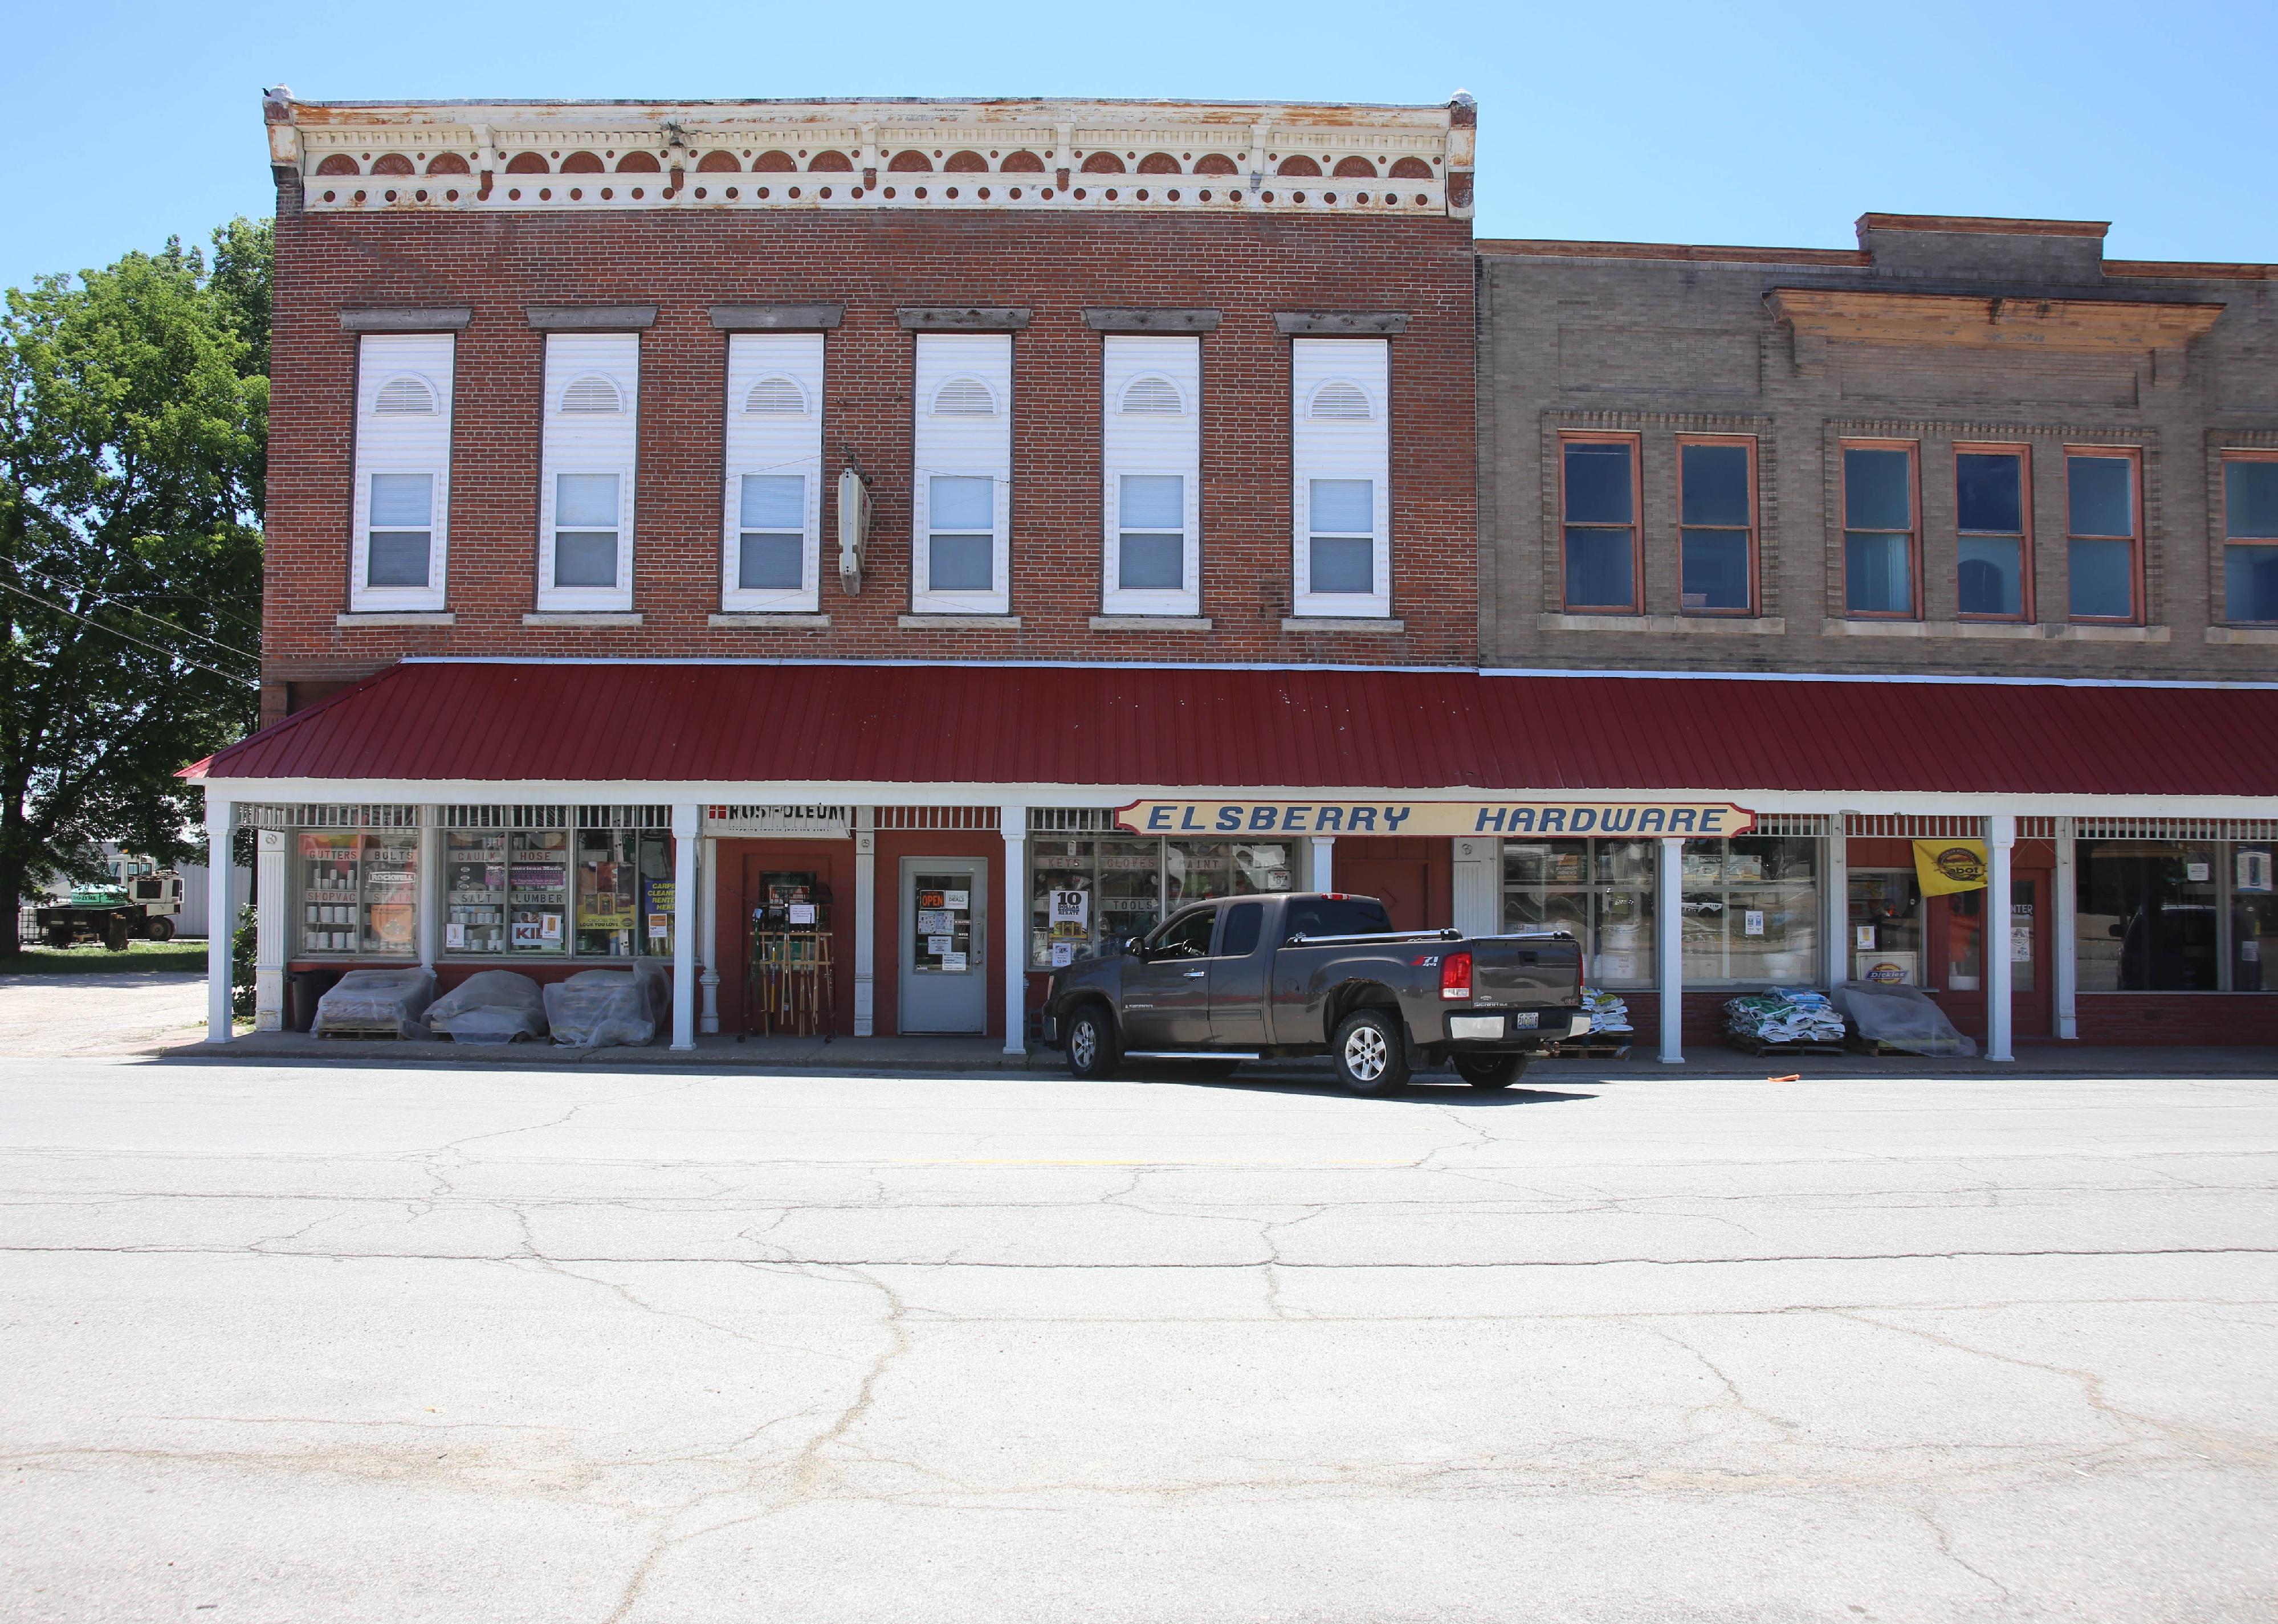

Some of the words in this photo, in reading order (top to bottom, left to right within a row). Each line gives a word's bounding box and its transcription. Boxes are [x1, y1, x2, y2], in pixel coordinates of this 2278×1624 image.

[1147, 806, 1410, 831] ELSBERRY
[1474, 807, 1729, 833] HARDWARE
[309, 851, 356, 859] GUTTERS
[374, 851, 413, 860] BOLTS
[458, 852, 496, 861] CAULK
[520, 852, 551, 860] HOSE
[1048, 858, 1080, 867] KEYS
[1107, 858, 1155, 867] GLOVES
[308, 892, 356, 901] SHOPVAC
[374, 893, 412, 901] STAIN
[462, 894, 492, 903] SALT
[516, 894, 563, 903] LUMBER
[922, 895, 943, 907] OPEN
[1057, 892, 1082, 905] 10
[1113, 901, 1152, 910] TOOLS
[2011, 904, 2033, 915] NTER
[516, 927, 543, 939] KIL
